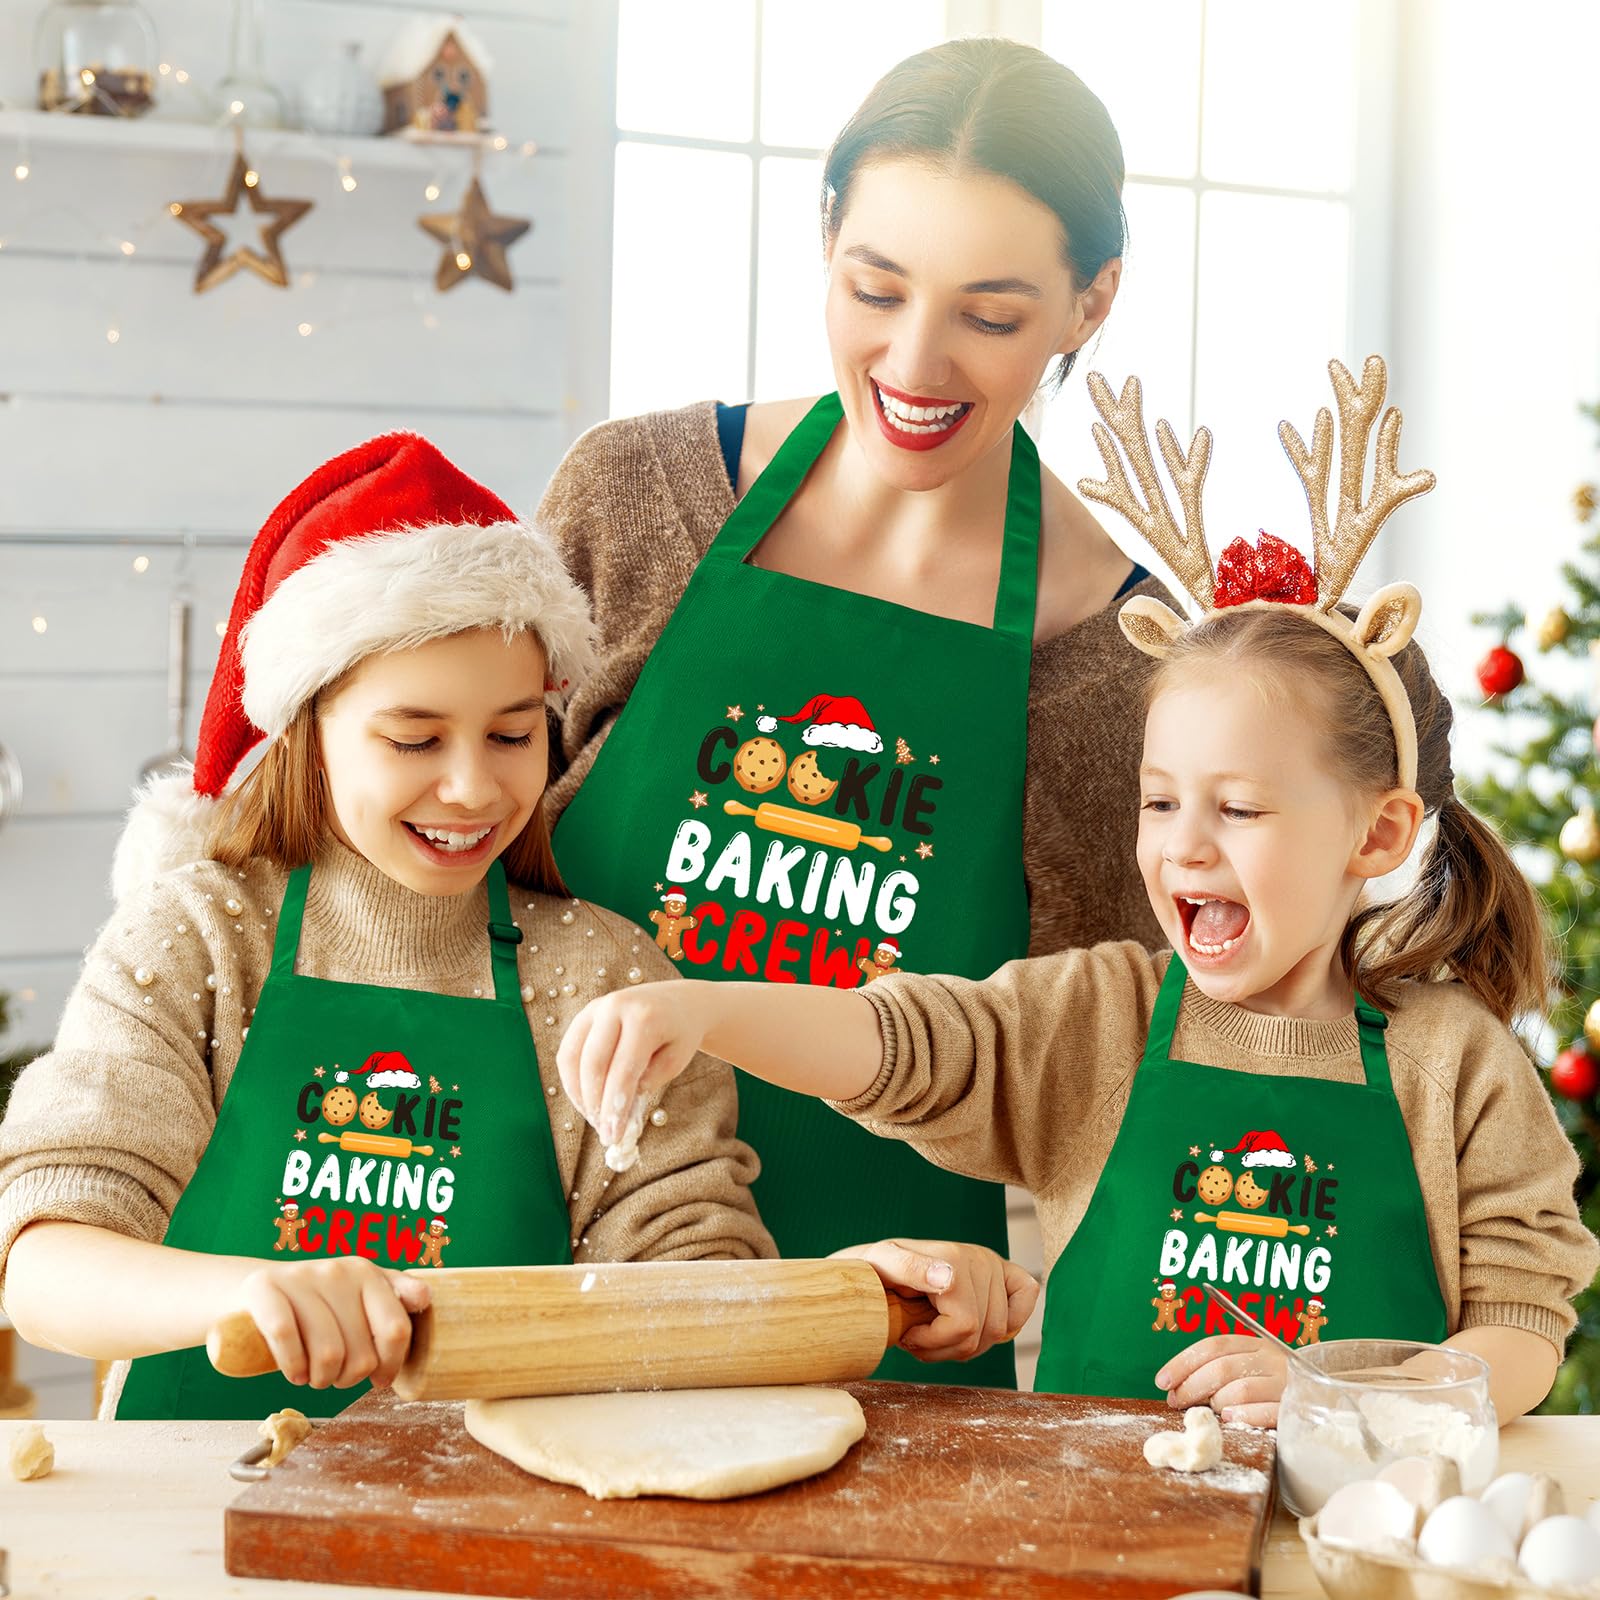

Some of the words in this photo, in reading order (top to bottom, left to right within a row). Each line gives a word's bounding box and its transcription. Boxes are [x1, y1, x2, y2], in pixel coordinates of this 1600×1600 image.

[696, 725, 945, 837] COOKIE
[665, 819, 920, 934] BAKING
[681, 901, 871, 990] CREW
[296, 1081, 464, 1142] COOKIE
[282, 1149, 455, 1213] BAKING
[1172, 1160, 1340, 1221] COOKIE
[297, 1206, 427, 1263] CREW
[1159, 1229, 1332, 1293] BAKING
[1175, 1286, 1305, 1343] CREW
